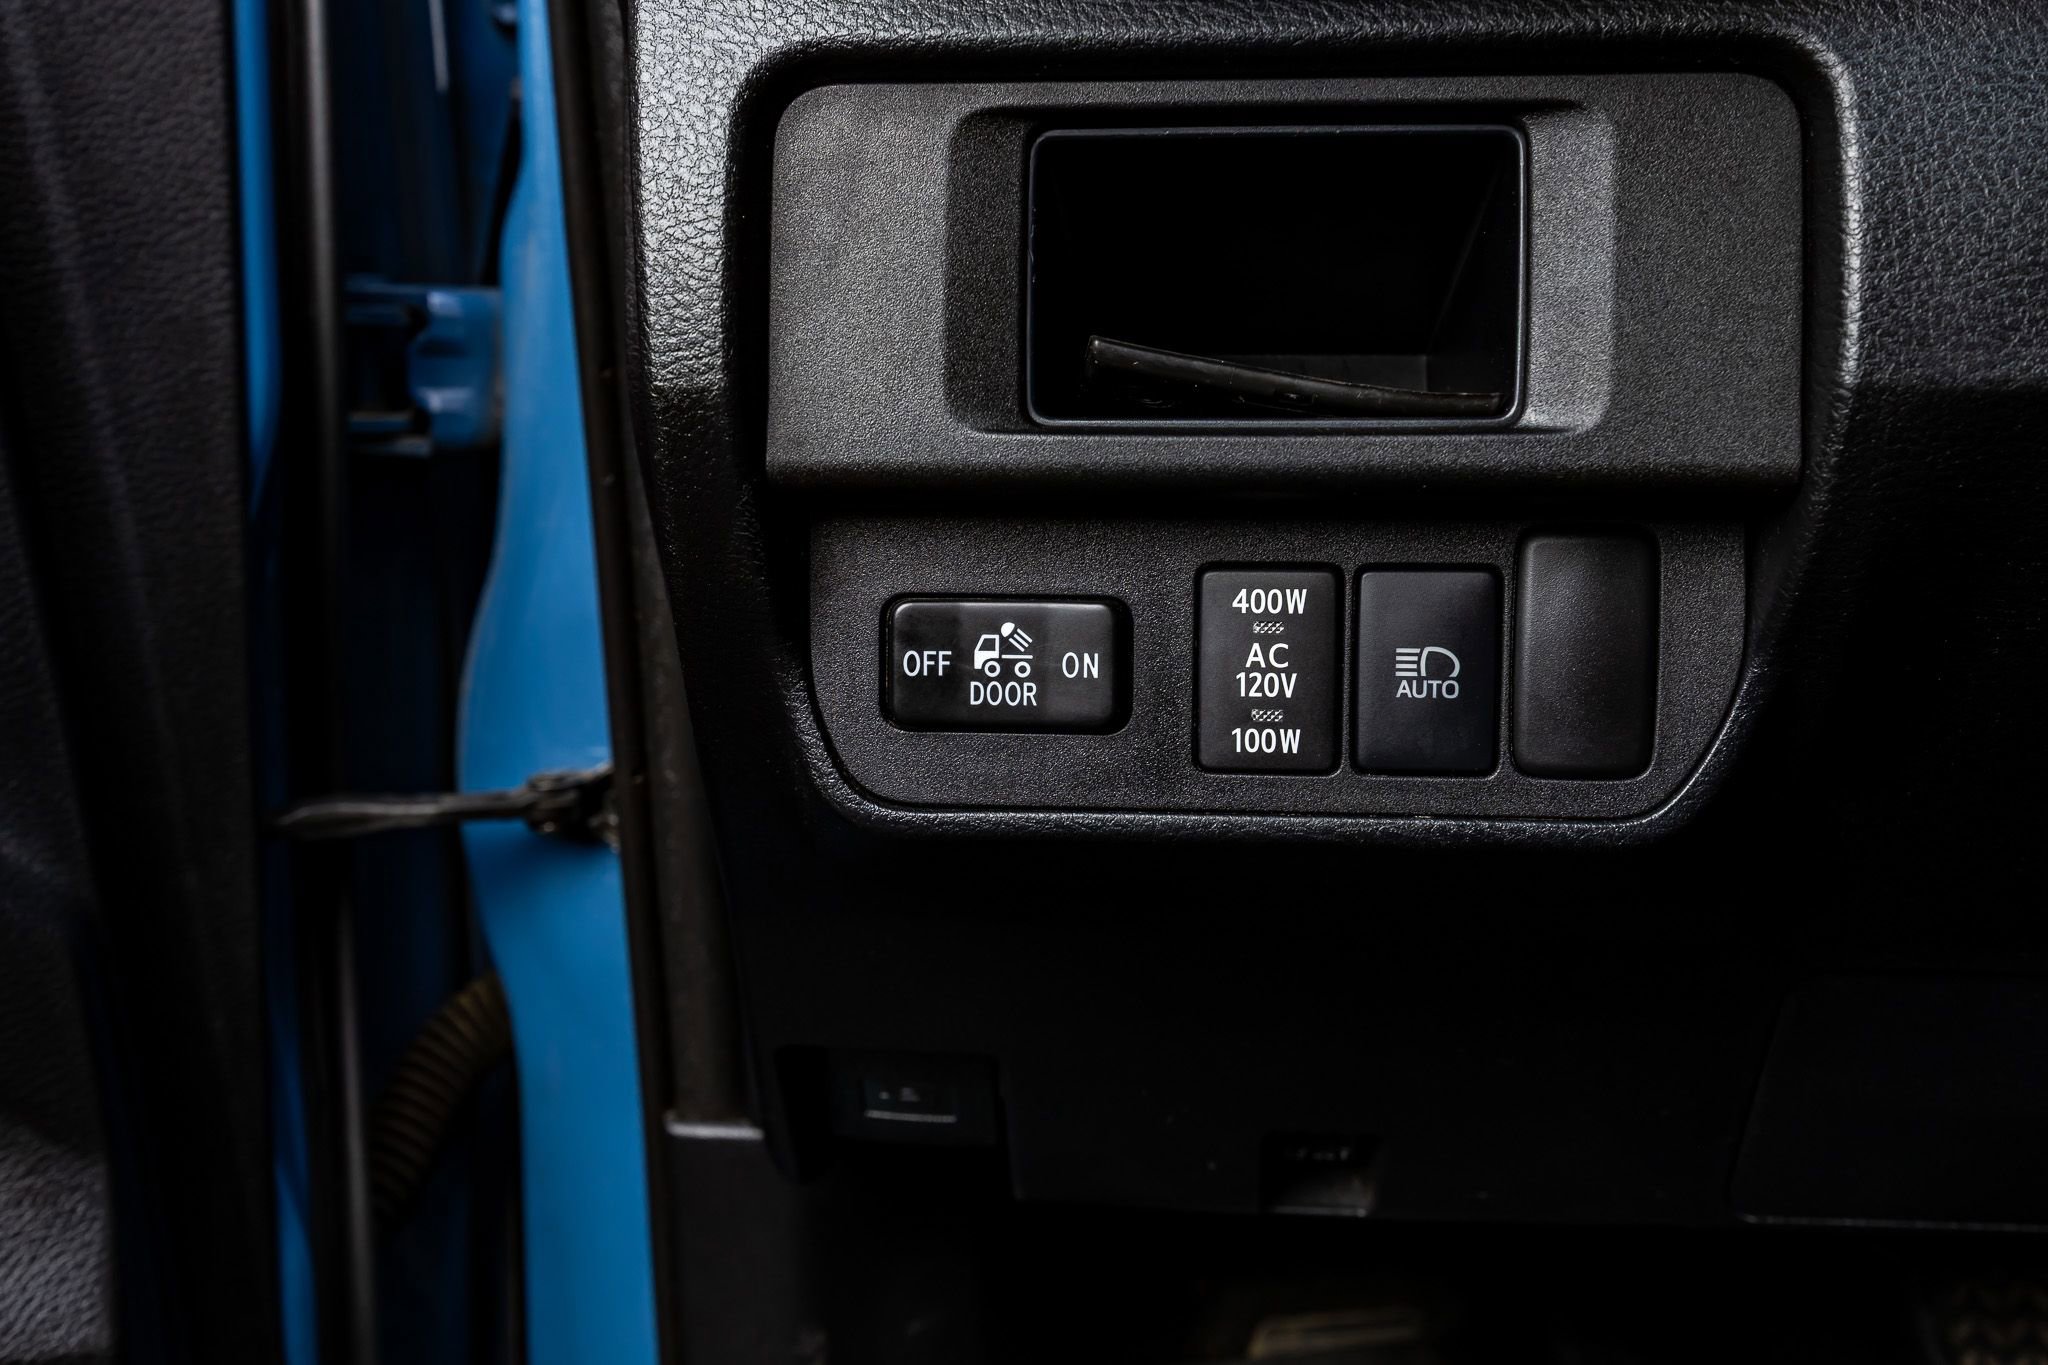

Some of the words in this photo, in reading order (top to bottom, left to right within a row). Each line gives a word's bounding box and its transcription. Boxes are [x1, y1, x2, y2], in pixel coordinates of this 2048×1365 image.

[1231, 588, 1308, 615] 400W
[902, 650, 953, 677] OFF
[1061, 651, 1099, 679] ON
[1245, 642, 1290, 669] AC
[969, 681, 1037, 707] DOOR
[1235, 671, 1298, 699] 120V
[1395, 679, 1460, 700] AUTO
[1230, 727, 1301, 754] 100W
